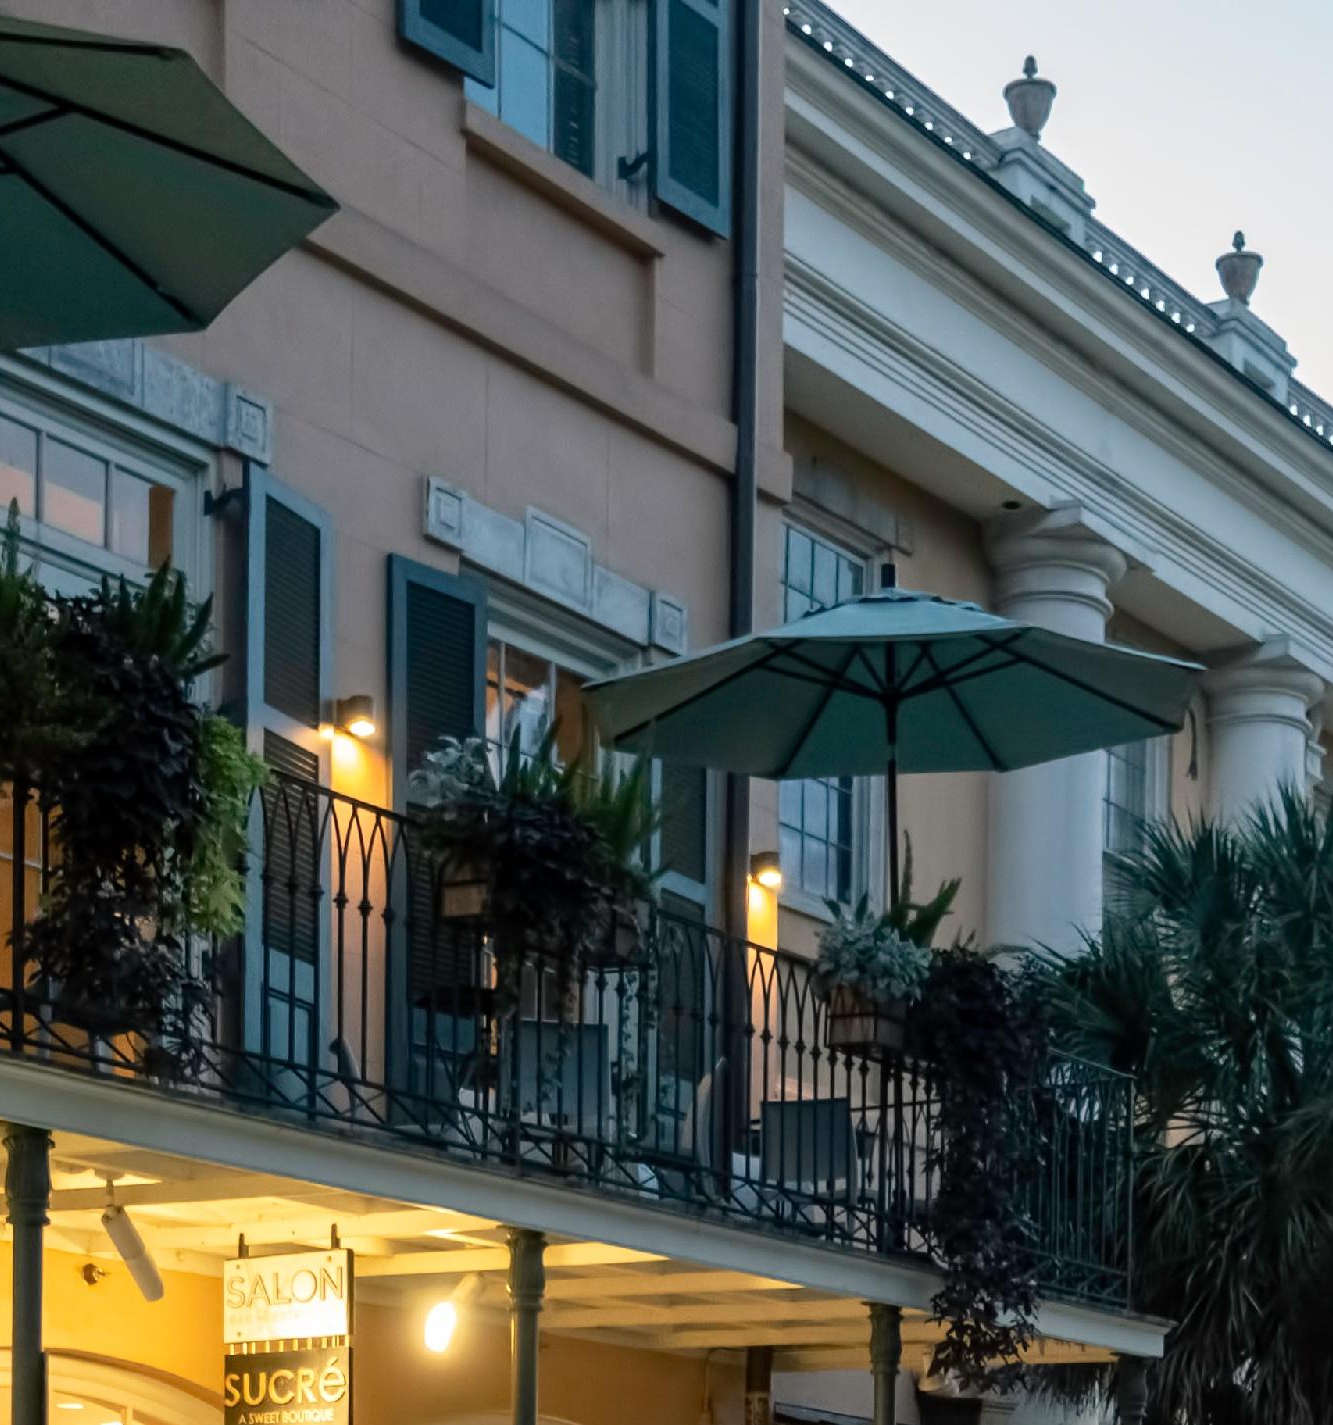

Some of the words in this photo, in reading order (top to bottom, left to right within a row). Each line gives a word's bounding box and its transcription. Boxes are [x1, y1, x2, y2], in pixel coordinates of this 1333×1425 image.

[227, 1266, 343, 1309] SALON
[224, 1357, 347, 1408] SUCRé
[238, 1413, 247, 1425] A
[249, 1411, 280, 1425] SWEET
[281, 1408, 333, 1423] BOUTIQUE
